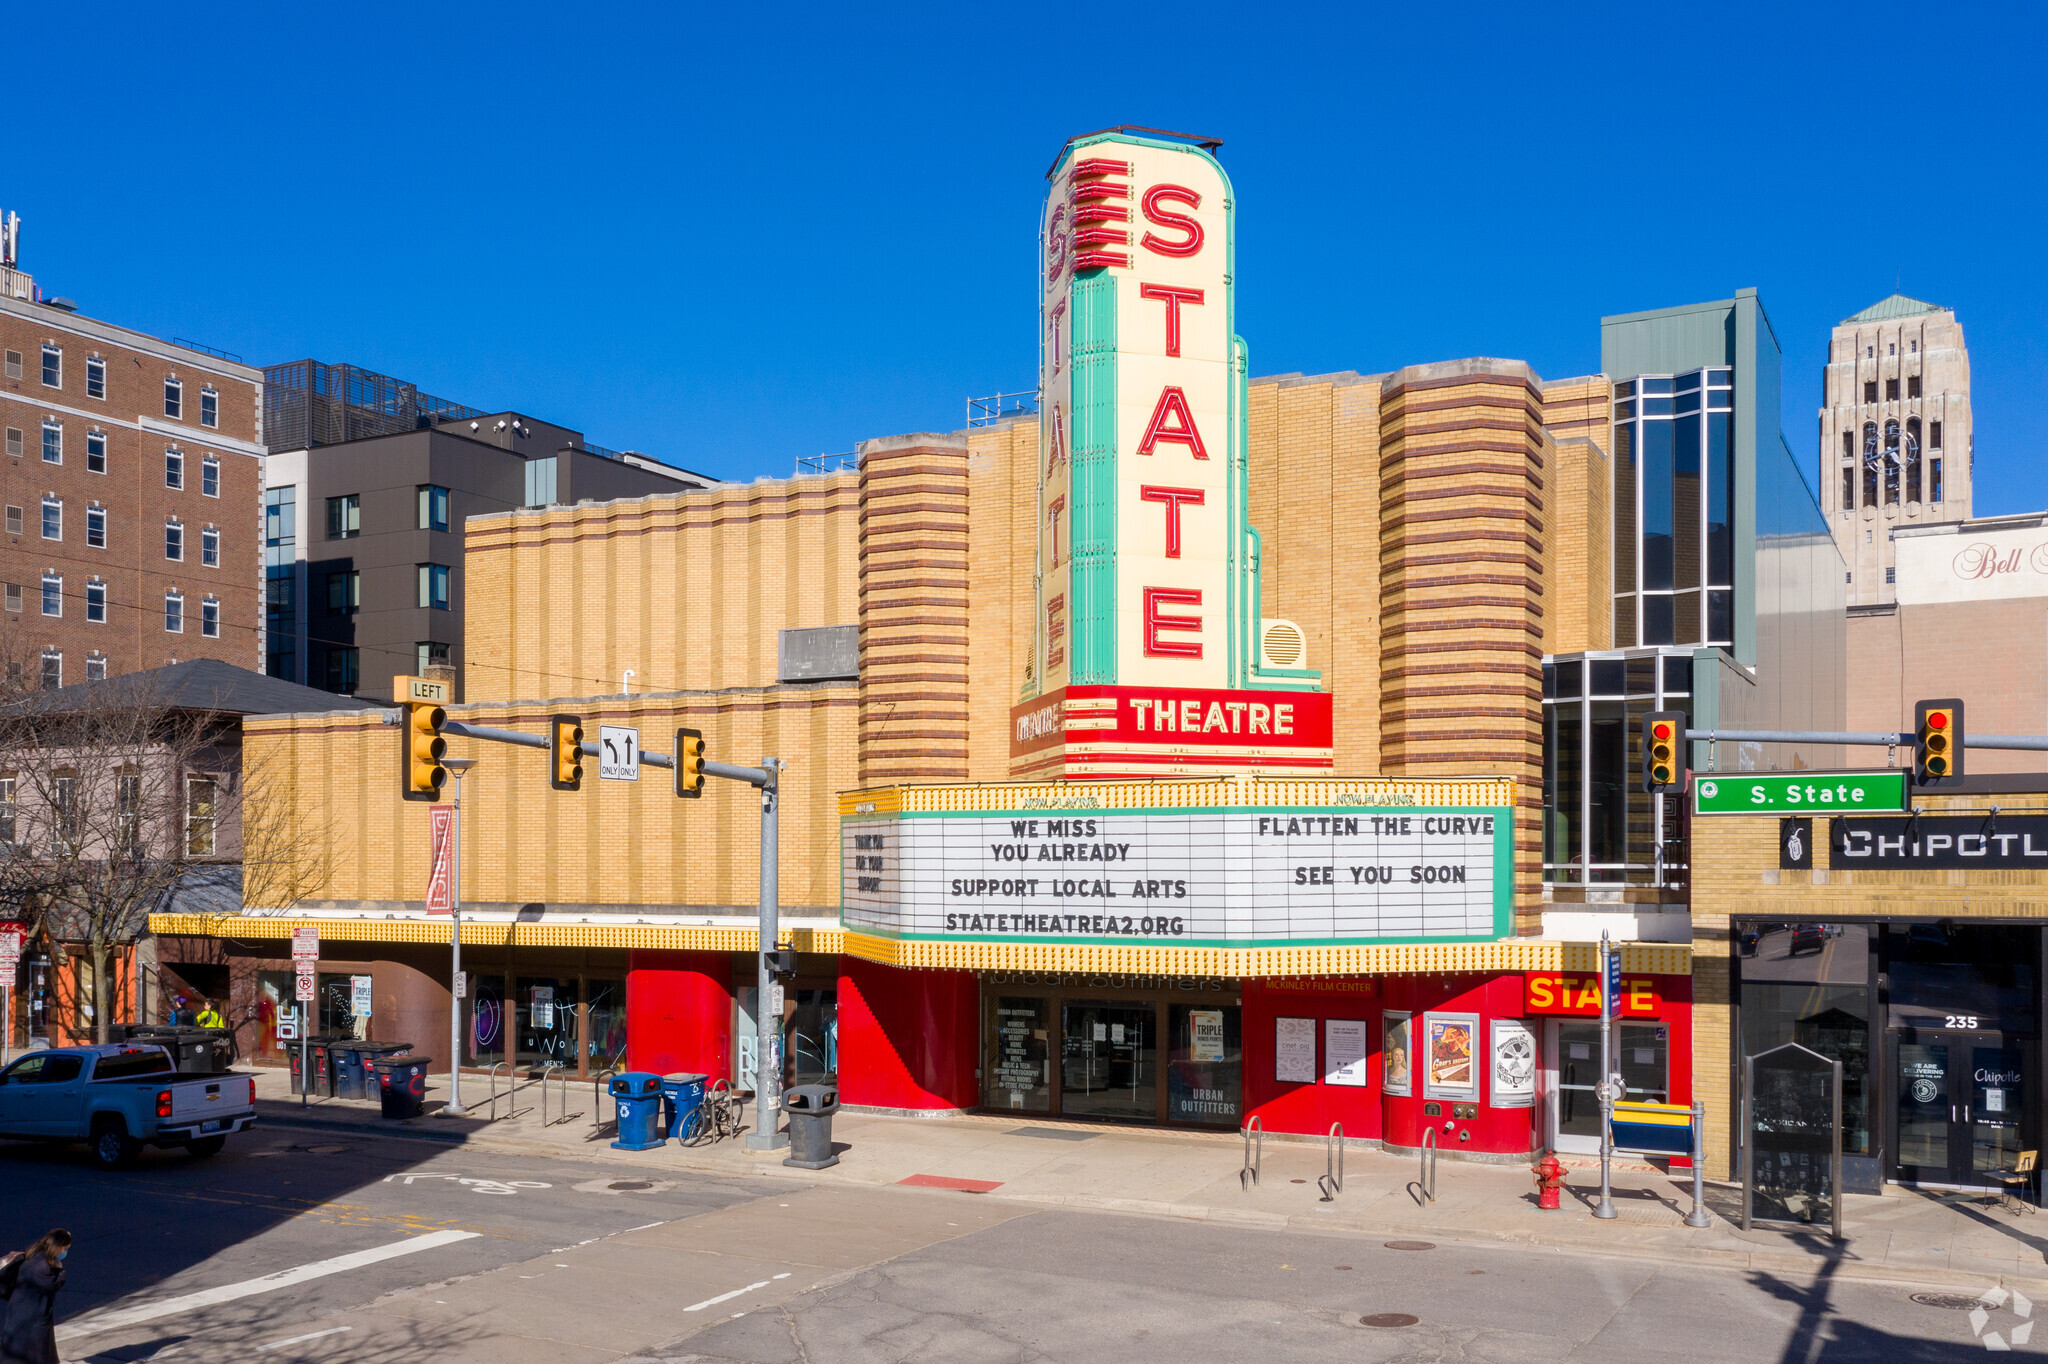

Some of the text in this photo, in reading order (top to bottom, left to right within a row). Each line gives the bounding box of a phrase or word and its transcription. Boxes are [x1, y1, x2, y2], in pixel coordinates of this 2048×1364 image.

[1136, 183, 1210, 660] STATE
[1953, 543, 2022, 580] Bell
[414, 682, 442, 699] LEFT
[1129, 698, 1294, 735] THEATRE
[602, 766, 618, 775] ONLY
[621, 768, 636, 777] ONLY
[1751, 784, 1865, 804] S. State
[1011, 819, 1097, 838] WE MISS
[1259, 816, 1494, 836] FLATTEN THE CURVE
[991, 843, 1130, 862] YOU ALREADY
[1295, 865, 1466, 885] SEE YOU SOON
[951, 878, 1187, 898] SUPPORT LOCAL ARTS
[993, 972, 1221, 991] urban outfitters
[1265, 980, 1371, 991] MCKINLEY FILM CENTER
[1530, 977, 1653, 1011] STAE
[1197, 1024, 1222, 1036] TRIPLE
[1945, 1015, 1978, 1029] 235
[532, 1059, 564, 1068] WOMEN'S
[1904, 1067, 1944, 1075] DELIVERING
[1974, 1068, 2021, 1085] Chipotle
[1193, 1088, 1223, 1101] URBAN
[1181, 1100, 1235, 1115] OUTFITTERS
